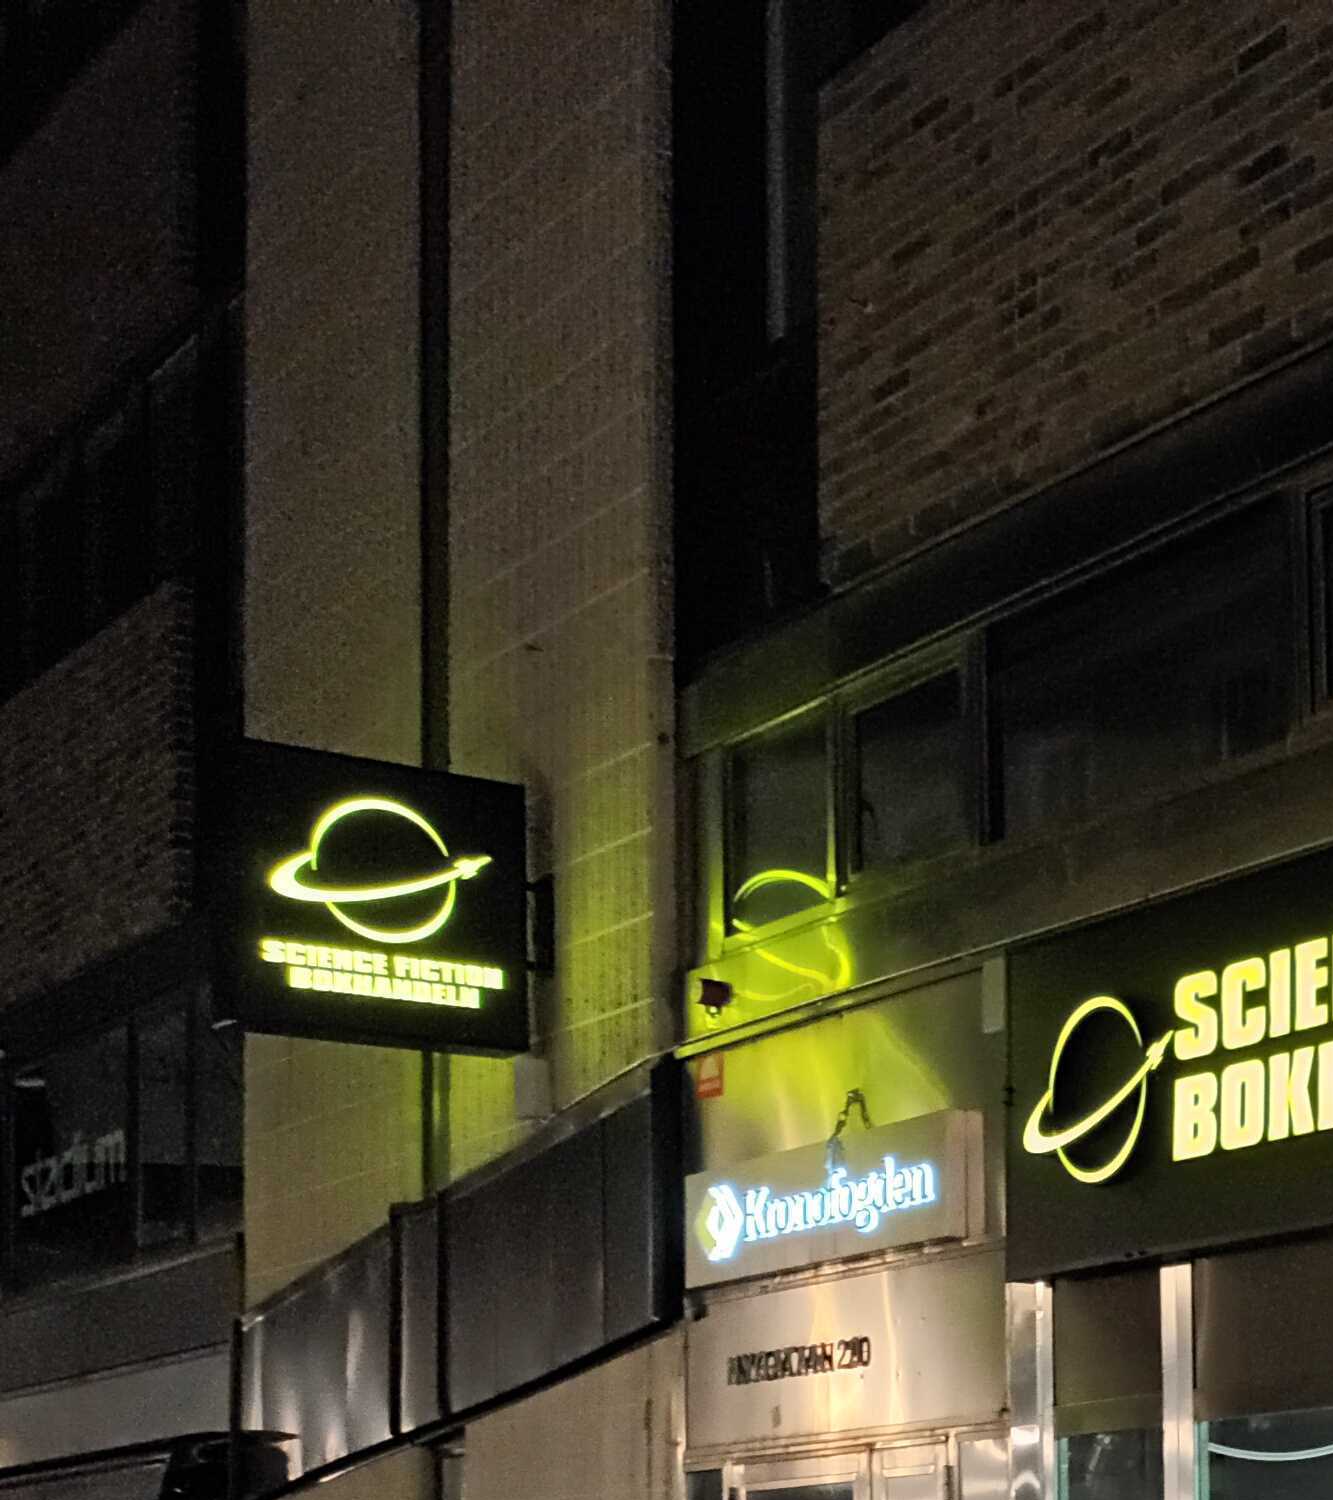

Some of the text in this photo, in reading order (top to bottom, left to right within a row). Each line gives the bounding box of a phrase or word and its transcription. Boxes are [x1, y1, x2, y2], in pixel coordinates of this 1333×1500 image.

[261, 939, 504, 990] SCIENCE FICTION
[288, 965, 481, 1009] BOKHANDELN
